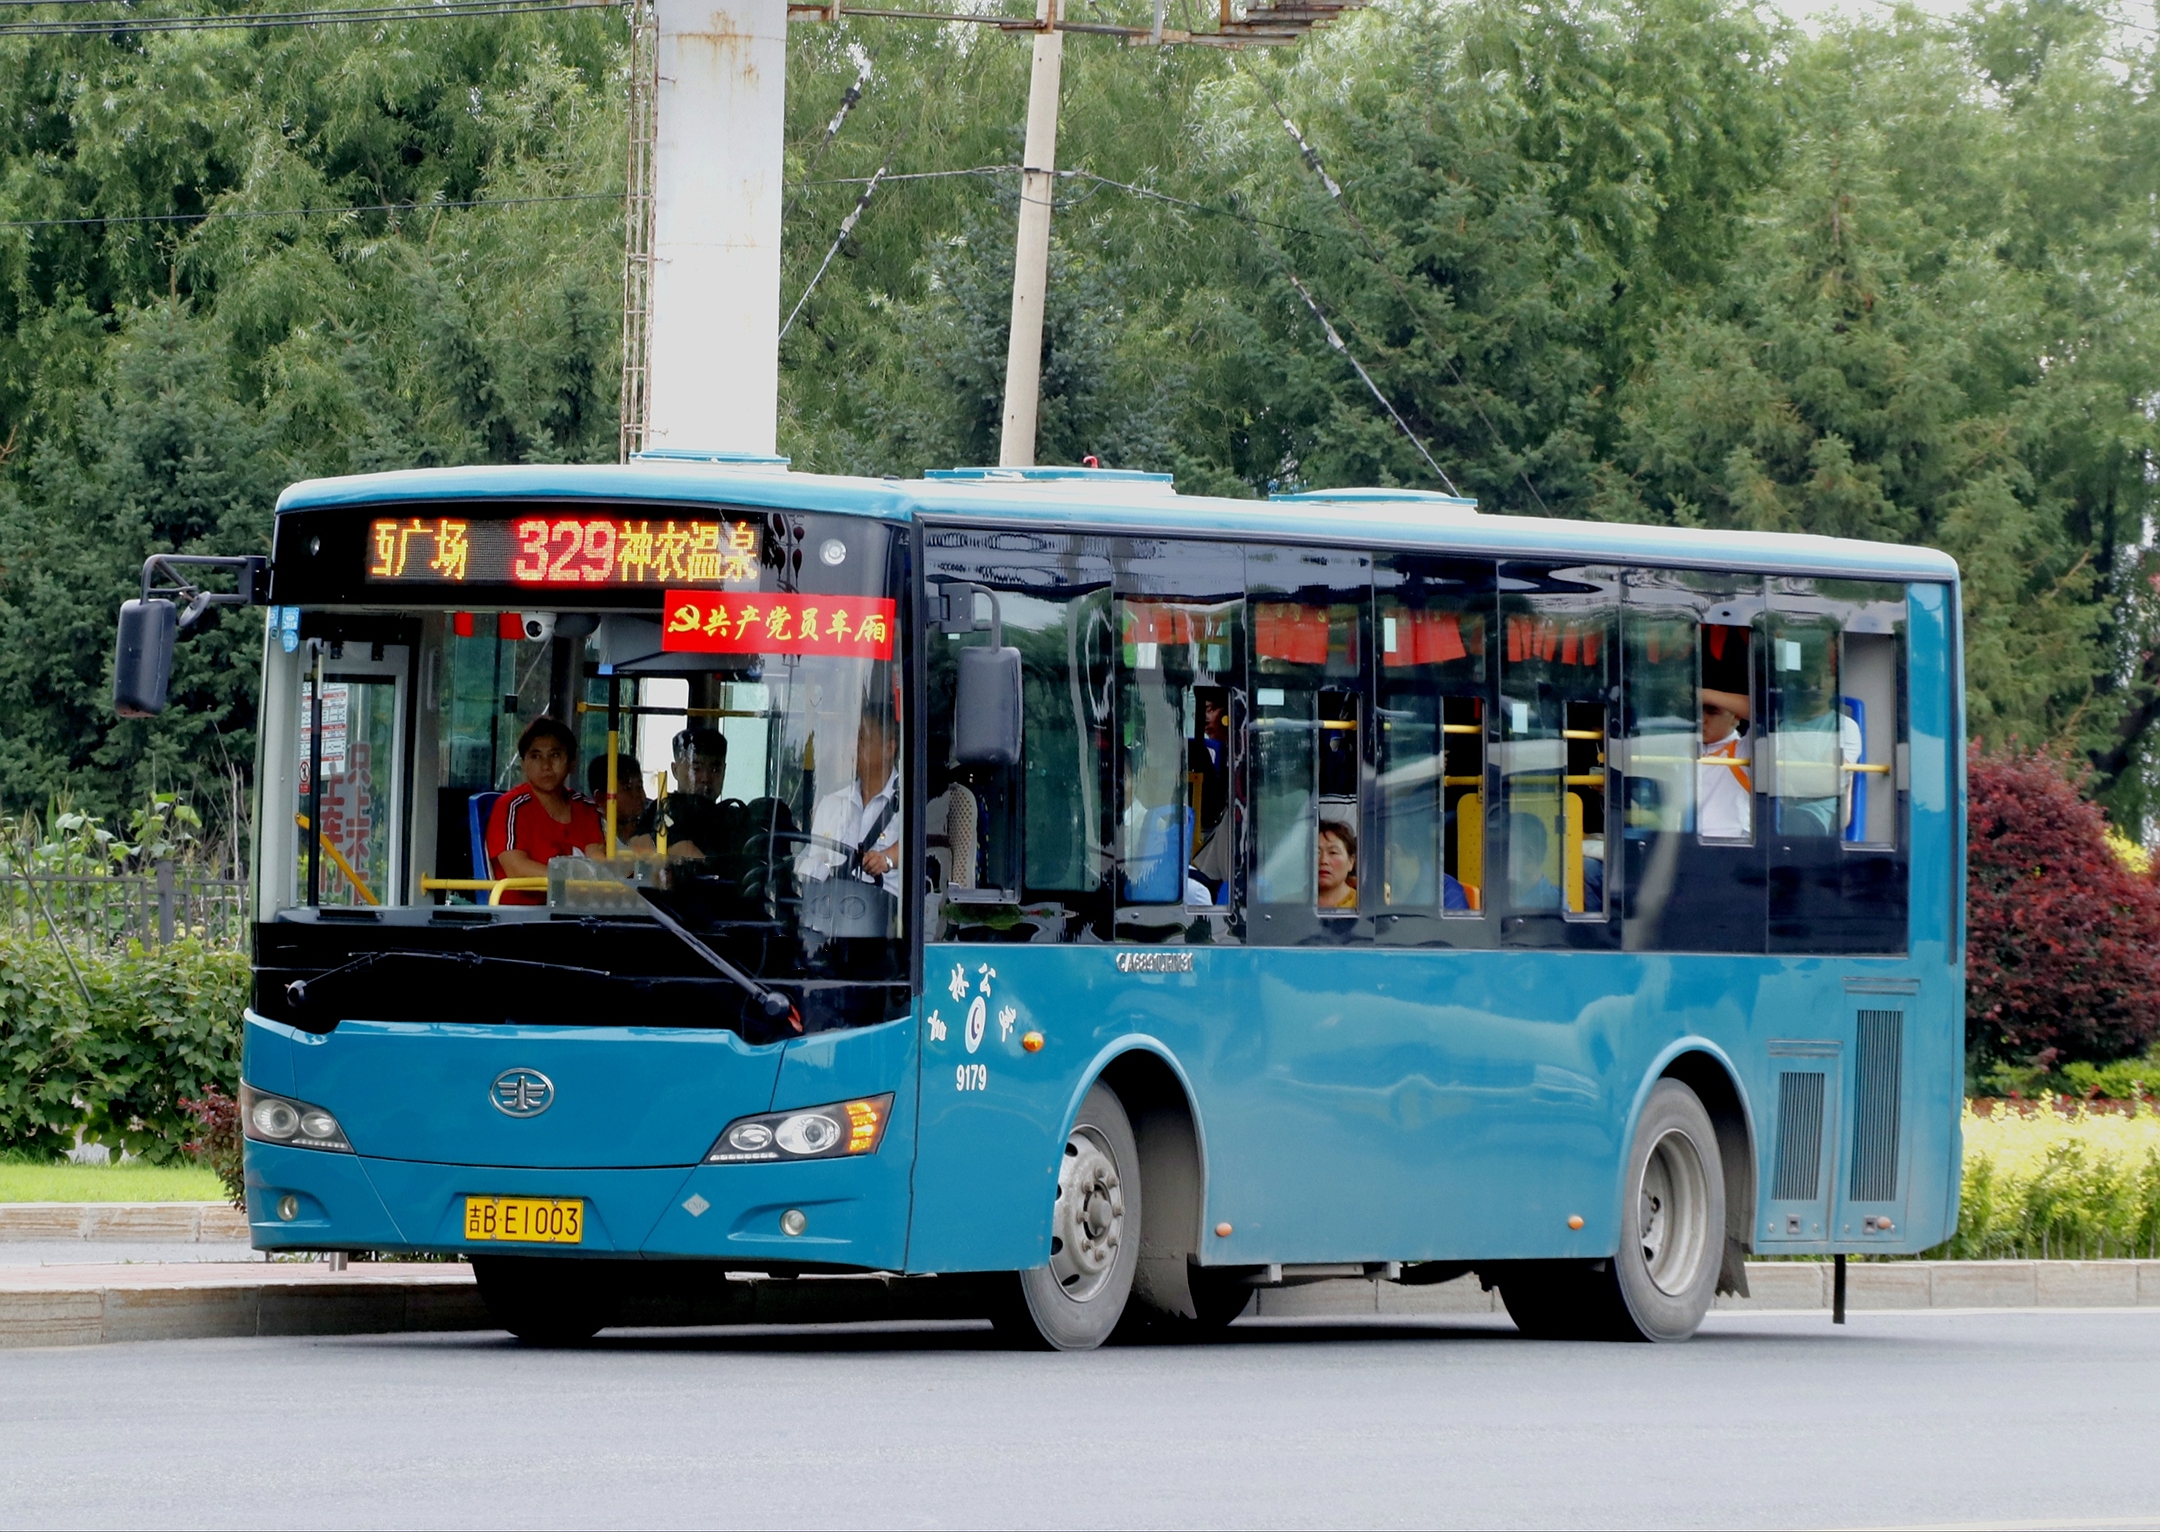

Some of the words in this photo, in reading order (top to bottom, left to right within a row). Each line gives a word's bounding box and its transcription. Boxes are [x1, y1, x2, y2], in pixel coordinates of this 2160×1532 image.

[514, 520, 617, 582] 329
[617, 521, 758, 583] 神农温泉
[702, 604, 887, 644] 共产党员车厢
[955, 1063, 987, 1091] 9179
